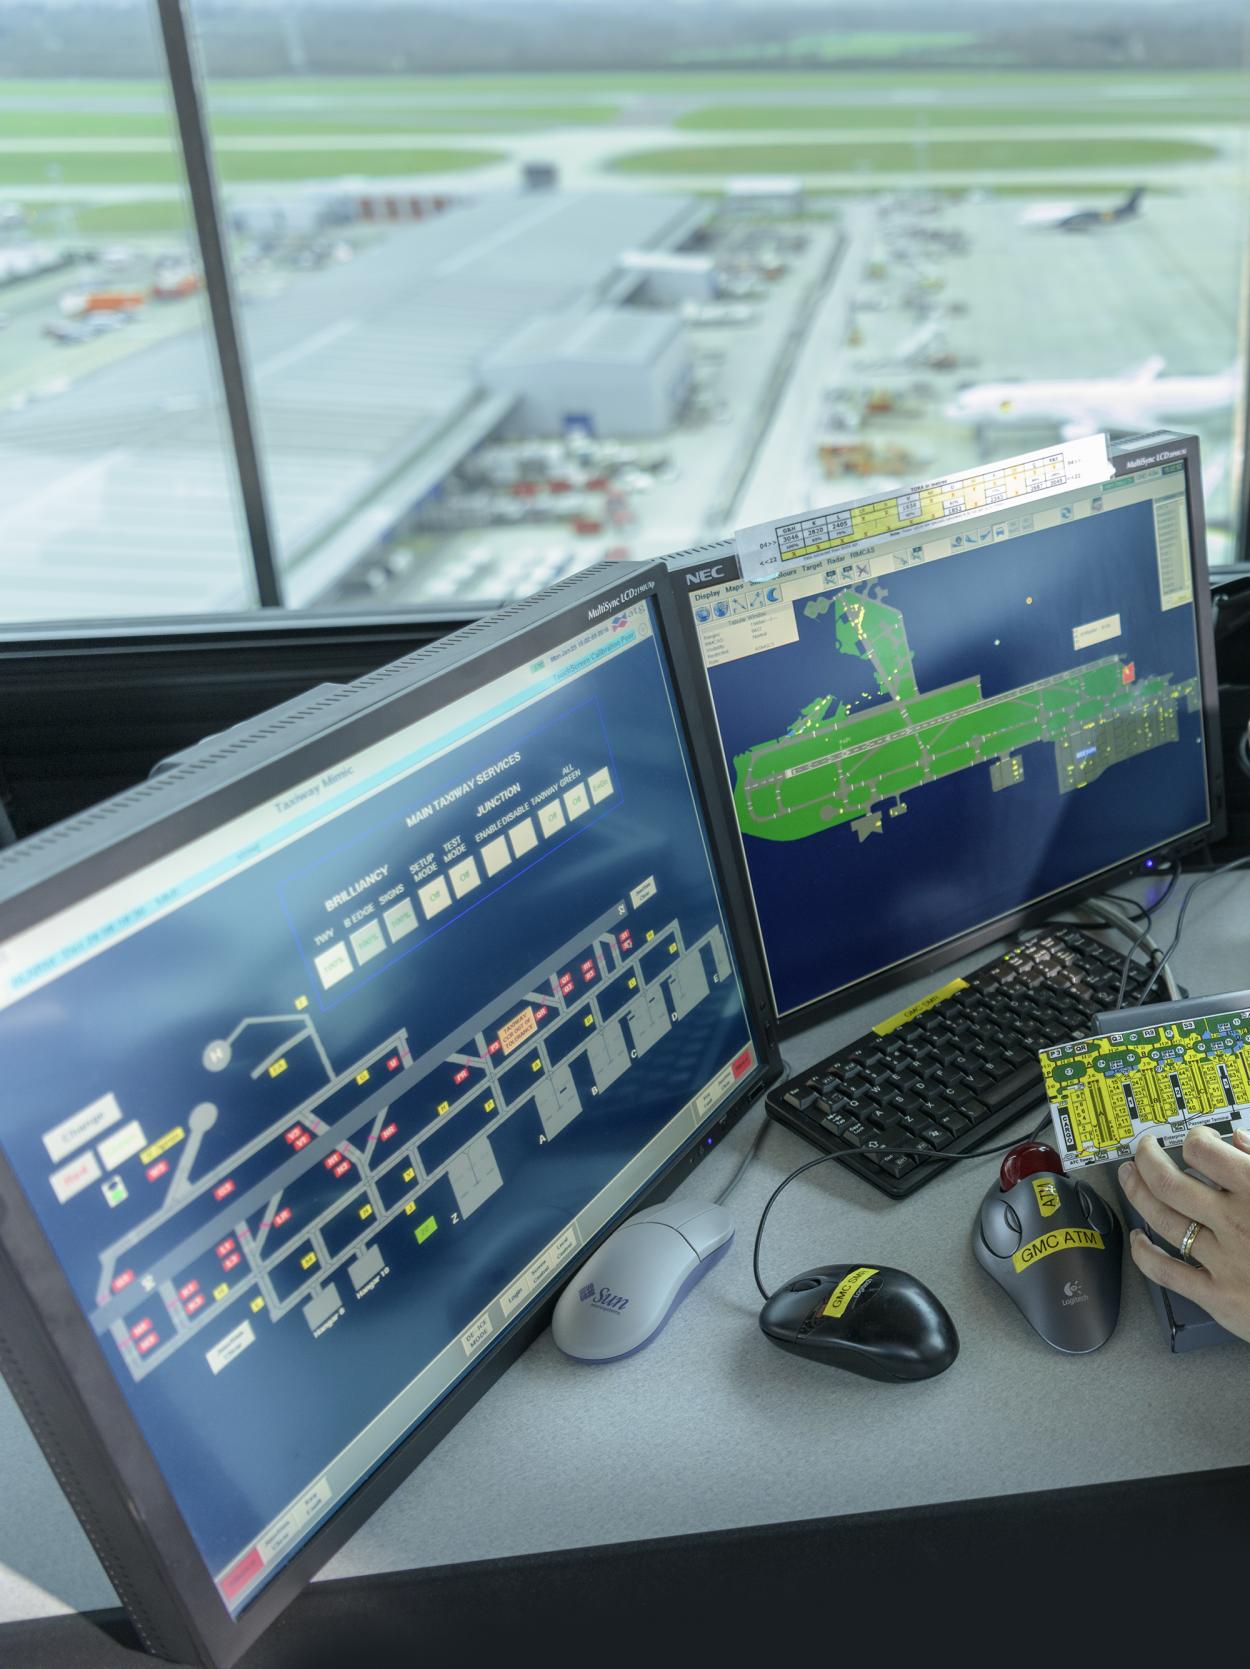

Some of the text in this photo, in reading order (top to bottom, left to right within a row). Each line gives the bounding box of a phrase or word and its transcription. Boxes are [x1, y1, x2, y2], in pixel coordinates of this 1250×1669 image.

[685, 565, 725, 585] NEC
[695, 589, 721, 601] Display
[725, 584, 744, 594] Maps
[802, 561, 823, 573] Target
[588, 598, 620, 621] MultiSync
[559, 769, 581, 788] GREEN
[562, 763, 574, 776] ALL
[405, 751, 521, 828] MAIN TAXIWAY SERVICES
[476, 783, 521, 817] JUNCTION
[475, 783, 559, 843] ENABLE DISABLE TAXIWAY
[443, 834, 462, 852] TEST
[443, 844, 467, 863] MODE
[409, 852, 435, 874] SETUP
[414, 862, 439, 882] MODE
[324, 864, 389, 912] BRILLIANCY
[378, 883, 405, 906] SIGNS
[314, 928, 335, 946] TWY
[1062, 1115, 1074, 1144] CARGO
[1037, 1183, 1056, 1207] ATM
[1021, 1231, 1097, 1263] GMC ATM
[592, 1287, 629, 1310] Sun
[832, 1284, 852, 1308] GMC
